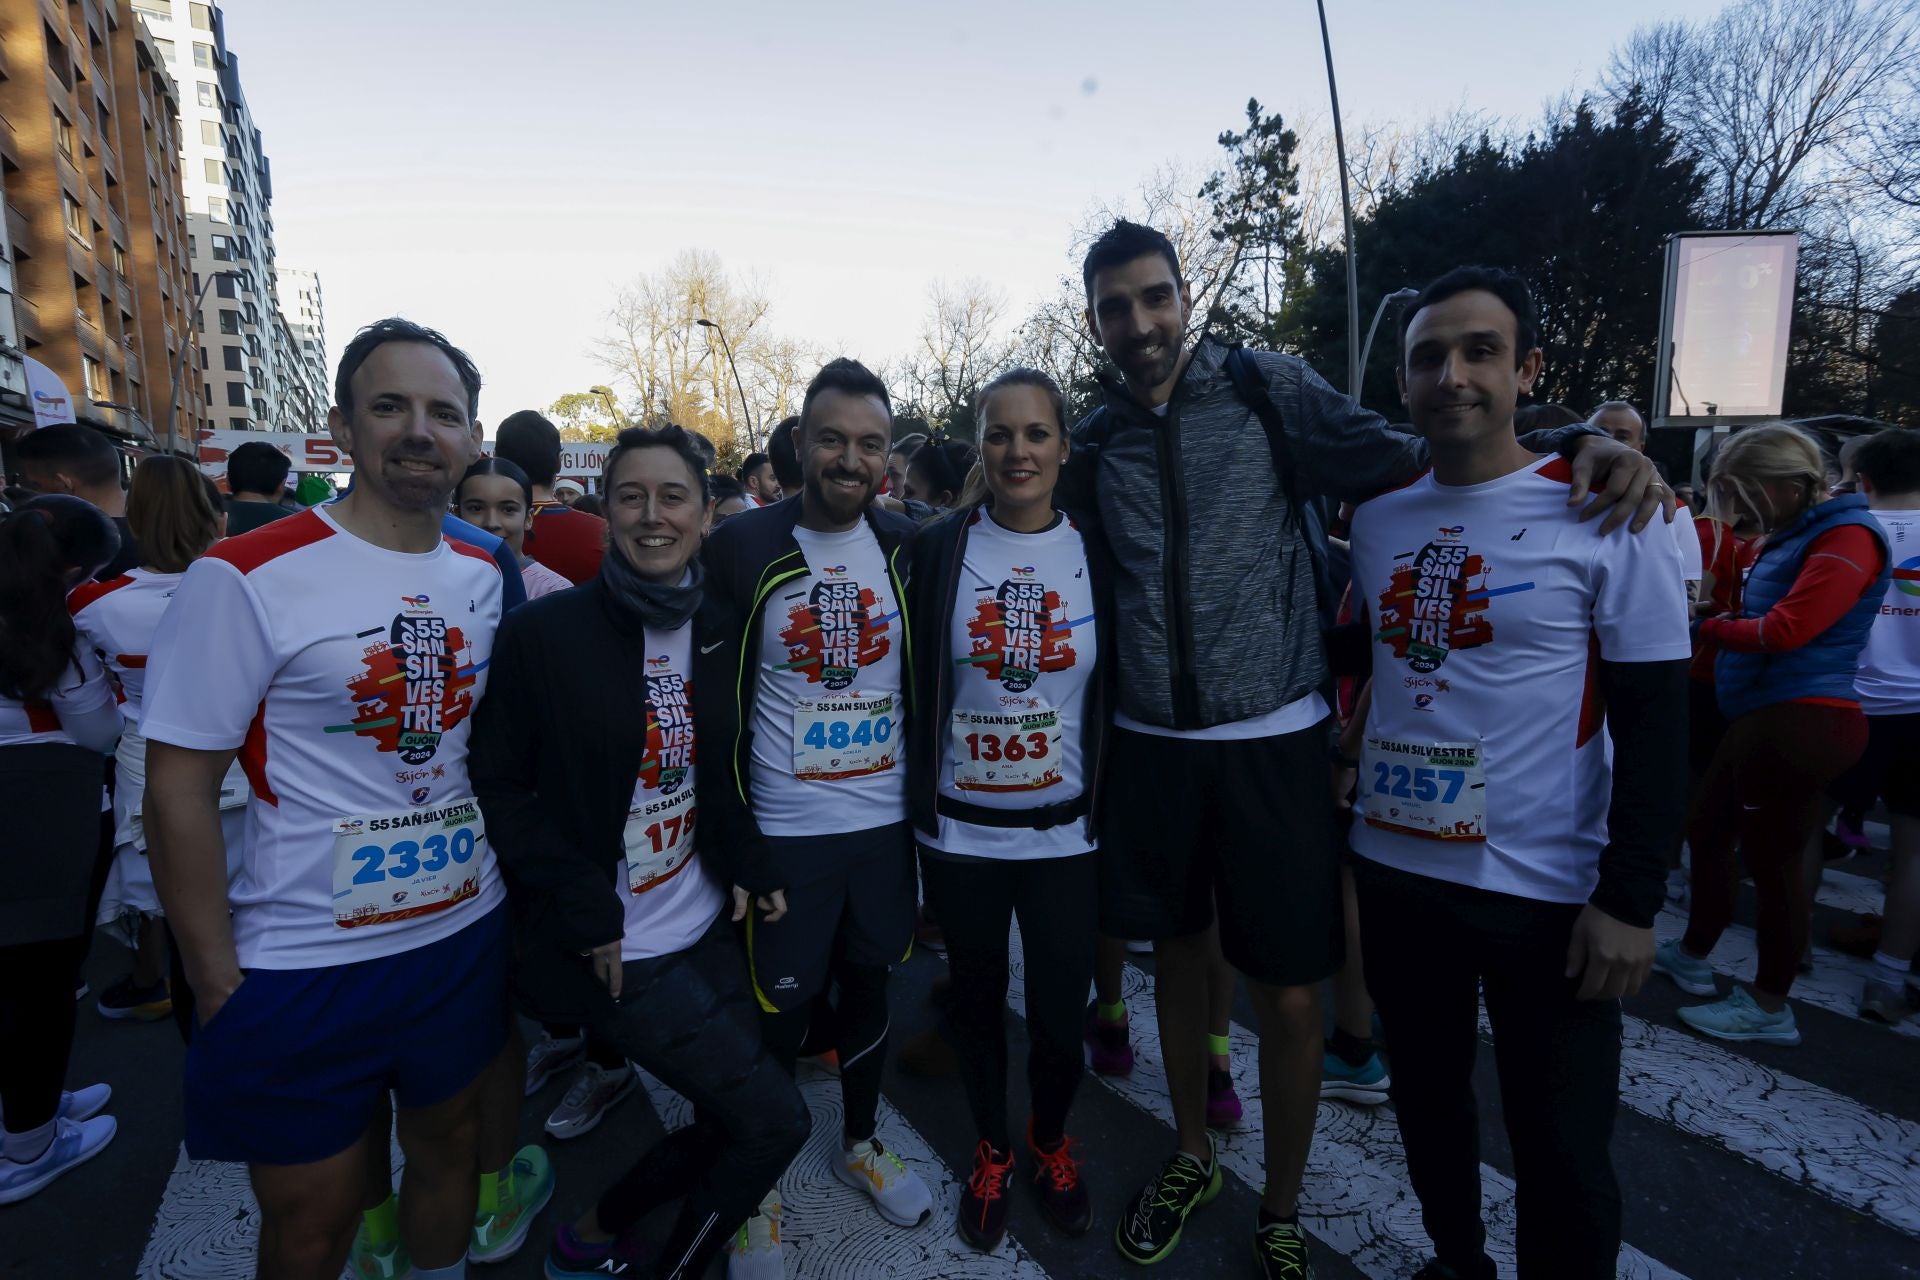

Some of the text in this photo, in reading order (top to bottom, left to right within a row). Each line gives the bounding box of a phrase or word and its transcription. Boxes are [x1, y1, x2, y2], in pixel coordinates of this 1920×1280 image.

[1437, 547, 1468, 564] 55
[1420, 557, 1460, 580] SAN
[832, 584, 858, 599] 55
[1019, 584, 1043, 599] 55
[1416, 577, 1454, 599] SIL
[819, 594, 858, 611] SAN
[1005, 591, 1042, 613] SAN
[1413, 598, 1451, 622] VES
[415, 619, 446, 639] 55
[820, 612, 858, 630] SIL
[1005, 609, 1041, 629] SIL
[401, 631, 445, 656] SAN
[821, 629, 860, 648] VES
[1004, 628, 1041, 649] VES
[1408, 619, 1450, 650] TRE
[405, 654, 444, 680] SIL
[820, 647, 859, 668] TRE
[1001, 645, 1041, 673] TRE
[1414, 662, 1435, 670] 2024
[405, 679, 445, 704] VES
[658, 675, 684, 693] 55
[648, 690, 689, 708] SAN
[817, 703, 831, 712] 55
[831, 703, 852, 712] SAN
[854, 696, 892, 711] SILVESTRE
[400, 703, 443, 734] TRE
[656, 706, 692, 728] SIL
[971, 710, 1055, 725] 55 SAN SILVESTRE
[660, 723, 694, 748] VES
[804, 716, 891, 750] 4840
[409, 750, 431, 760] 2024
[658, 743, 692, 768] TRE
[965, 732, 1049, 762] 1363
[1381, 741, 1475, 758] 55 SAN SILVESTRE
[1374, 761, 1465, 804] 2257
[646, 804, 660, 815] 55
[661, 796, 681, 811] SAN
[369, 819, 390, 832] 55
[391, 813, 422, 829] SAN
[423, 802, 475, 824] SILVESTRE
[351, 827, 475, 885] 2330
[411, 875, 437, 885] JAVIER
